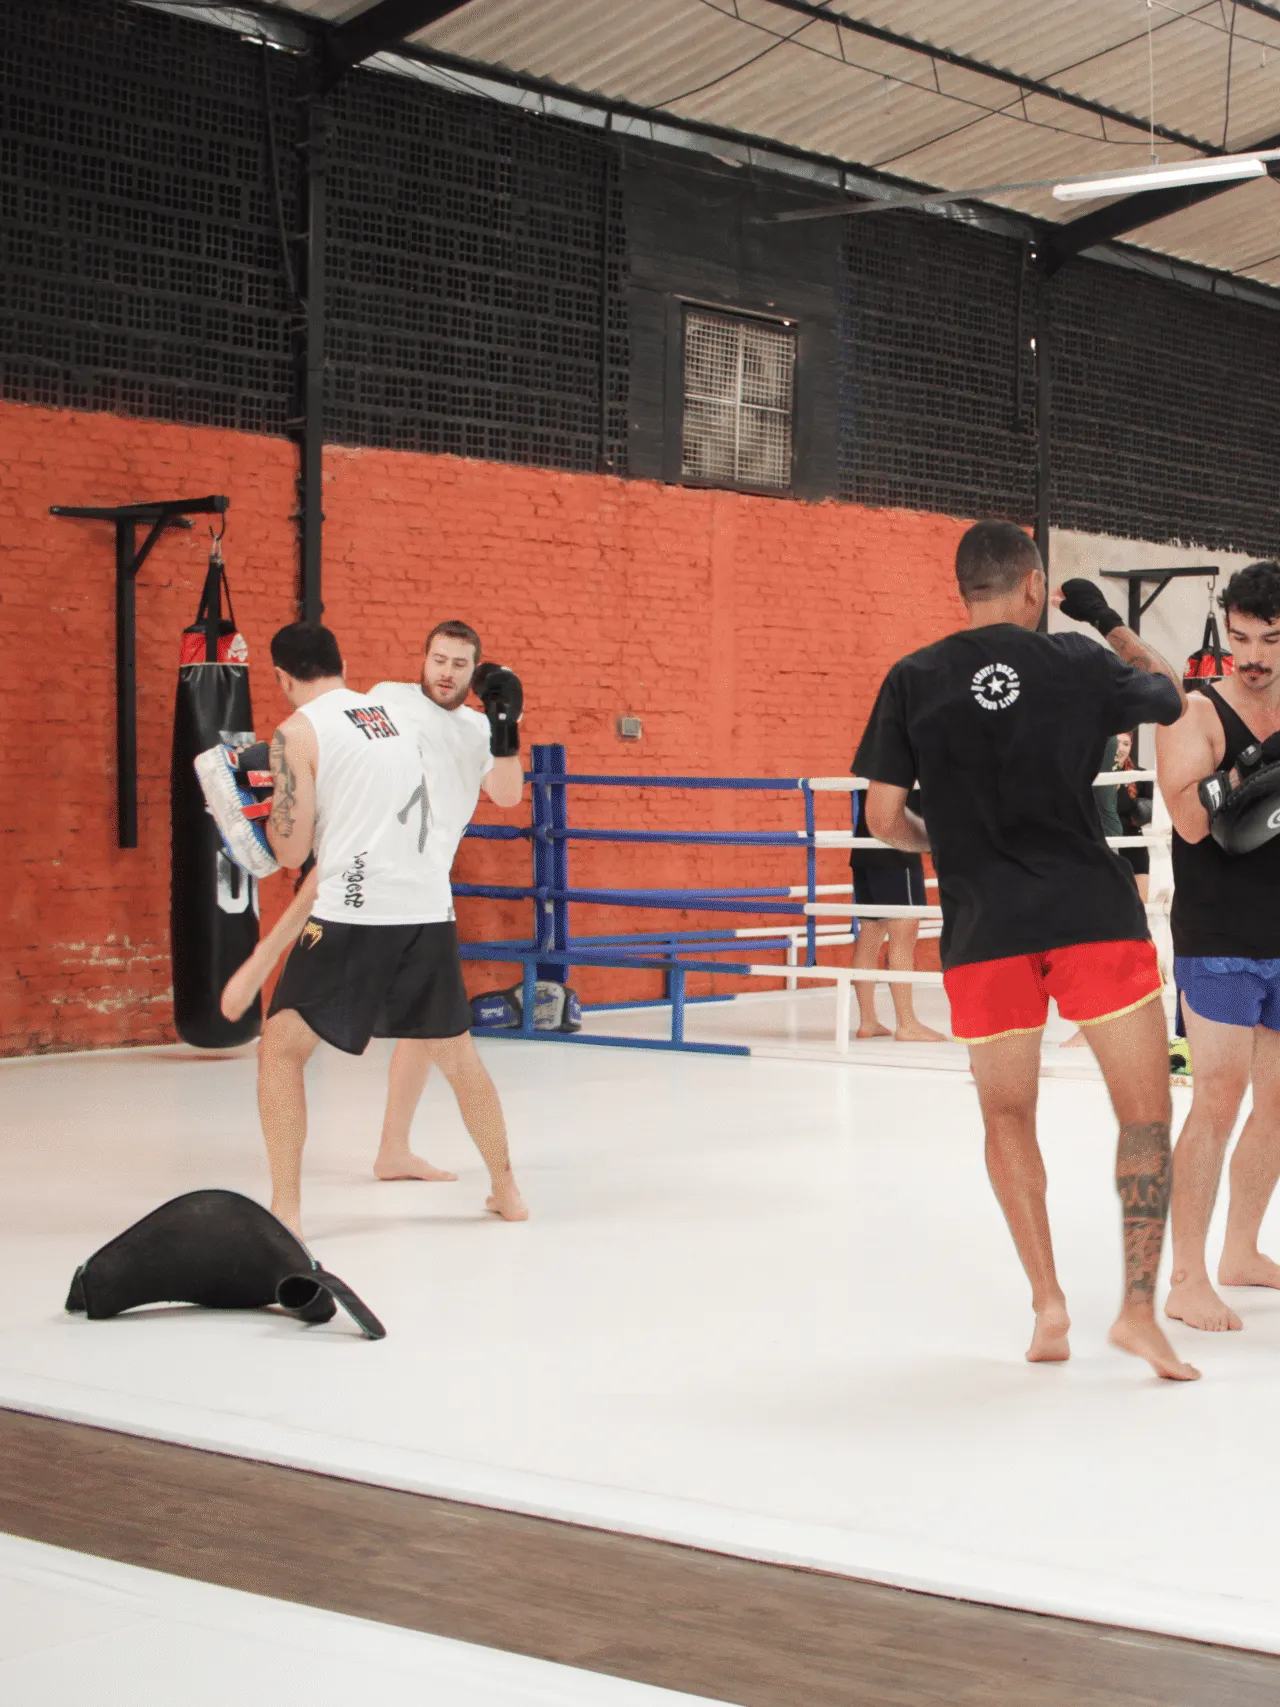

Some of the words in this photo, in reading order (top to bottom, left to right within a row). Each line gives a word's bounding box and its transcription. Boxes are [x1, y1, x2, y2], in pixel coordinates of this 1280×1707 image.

[998, 689, 1020, 709] LIMA
[343, 705, 388, 727] MUAY
[357, 722, 400, 740] THAI
